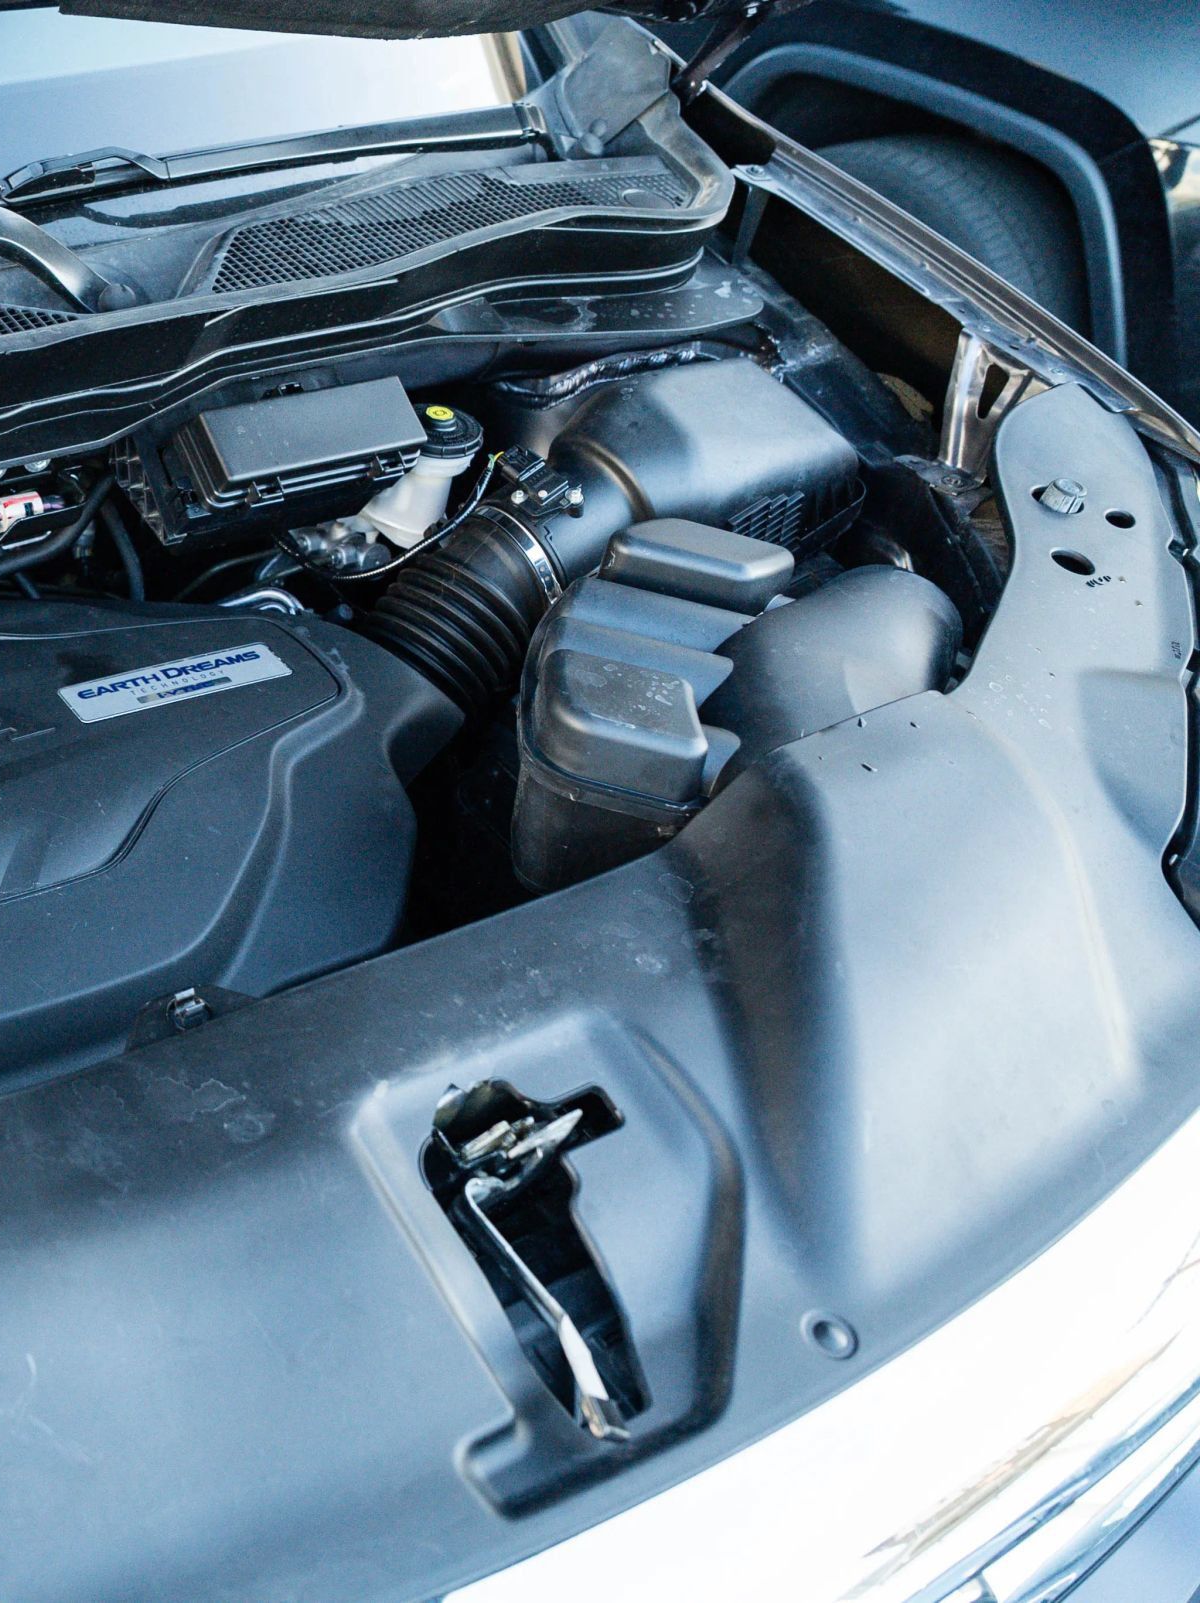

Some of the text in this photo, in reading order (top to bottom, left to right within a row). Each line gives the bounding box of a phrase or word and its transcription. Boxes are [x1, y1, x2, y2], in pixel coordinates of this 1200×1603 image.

[77, 650, 260, 700] EARTH DREAMS
[130, 669, 225, 696] TECHNOLOGY
